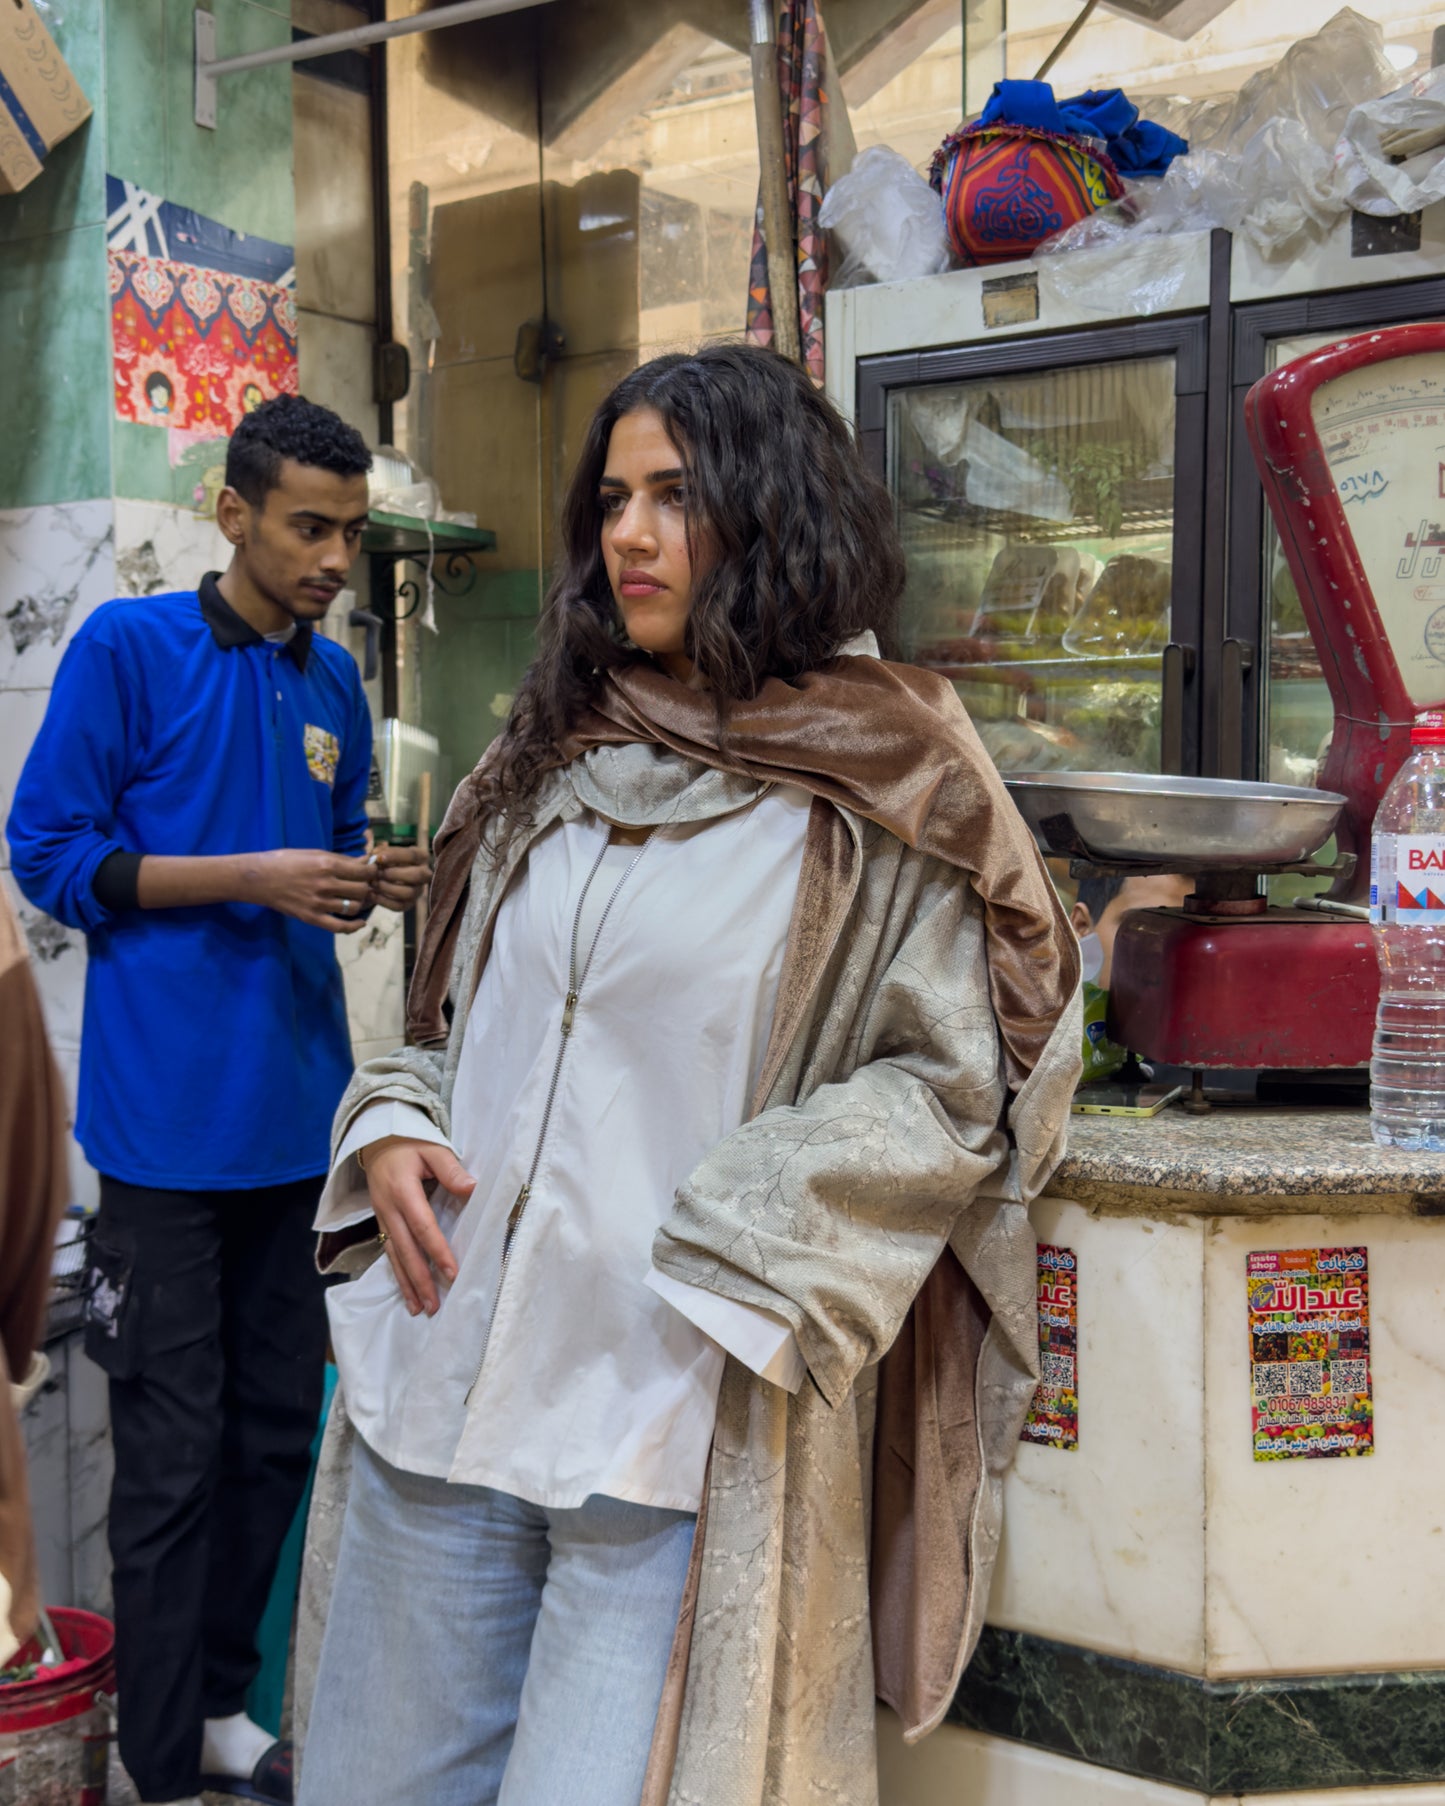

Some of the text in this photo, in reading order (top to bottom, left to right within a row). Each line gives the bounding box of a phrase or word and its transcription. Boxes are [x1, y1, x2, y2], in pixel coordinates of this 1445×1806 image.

[1340, 470, 1384, 491] ٥٦٧٨
[1408, 849, 1445, 871] BA
[1250, 1254, 1277, 1263] insta
[1269, 1396, 1347, 1412] 01067985834
